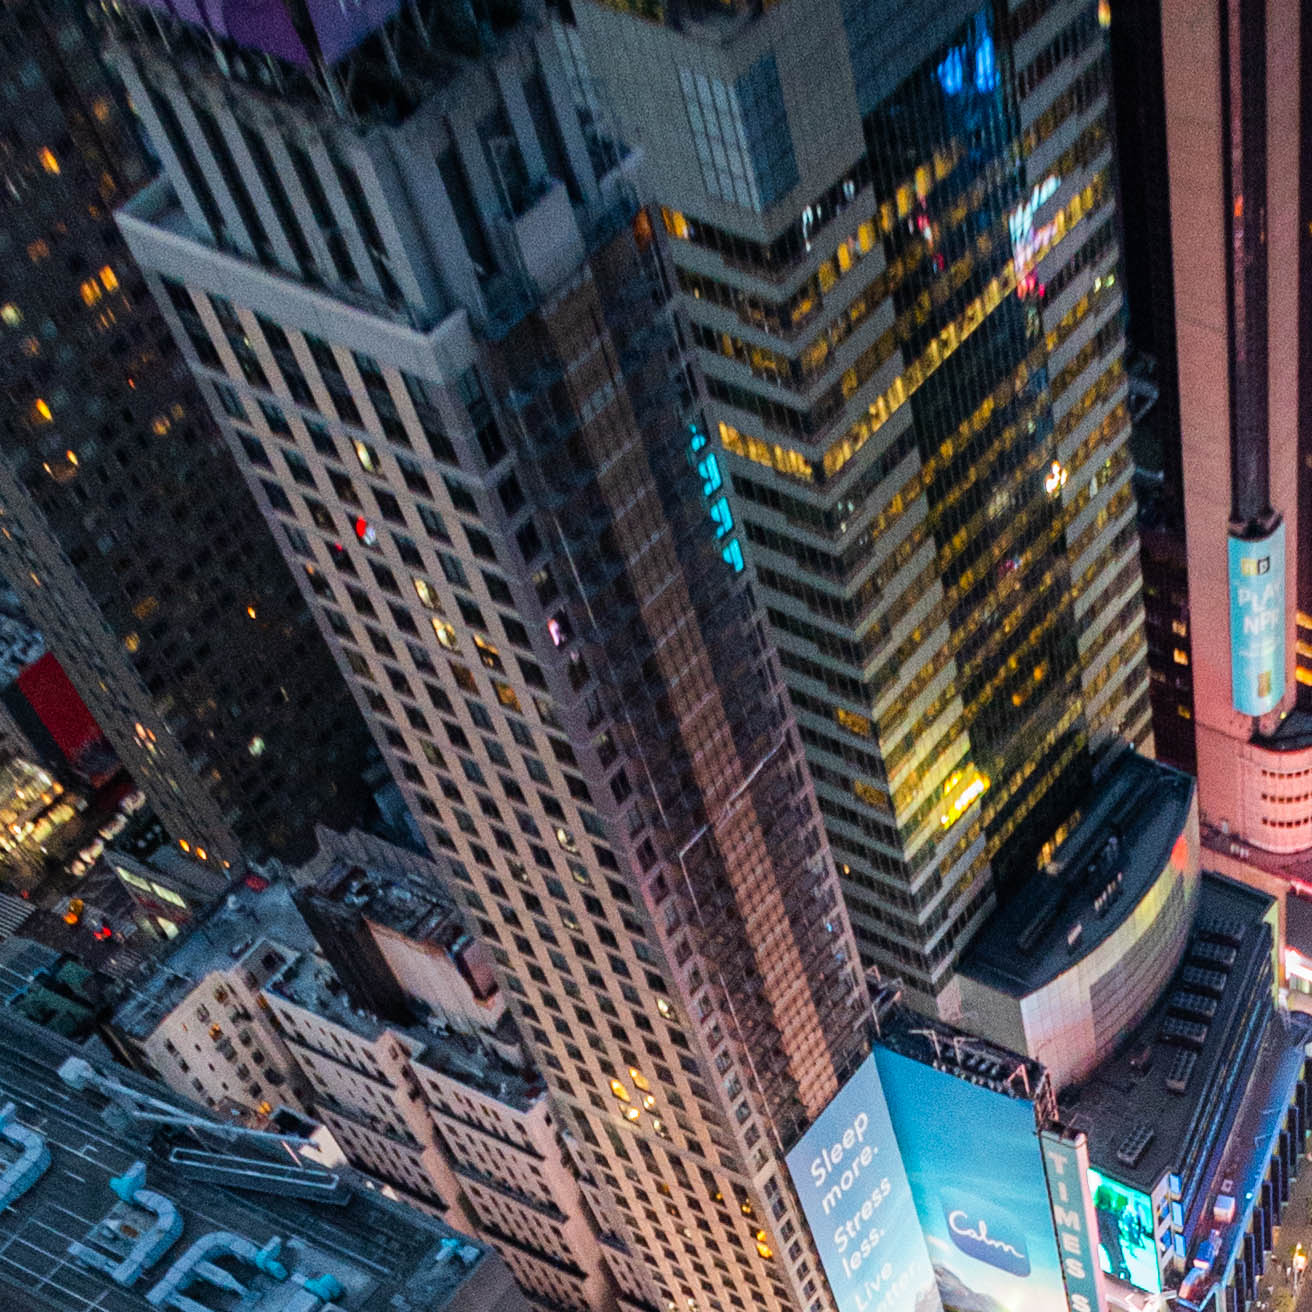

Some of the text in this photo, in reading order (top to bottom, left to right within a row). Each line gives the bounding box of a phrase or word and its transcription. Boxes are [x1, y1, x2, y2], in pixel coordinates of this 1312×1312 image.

[810, 1111, 869, 1188] Sleep
[821, 1143, 879, 1216] more.
[833, 1177, 892, 1253] Stress
[948, 1209, 1026, 1259] Calm
[1046, 1150, 1086, 1280] TIMES
[842, 1226, 886, 1279] less.
[854, 1261, 893, 1312] Live
